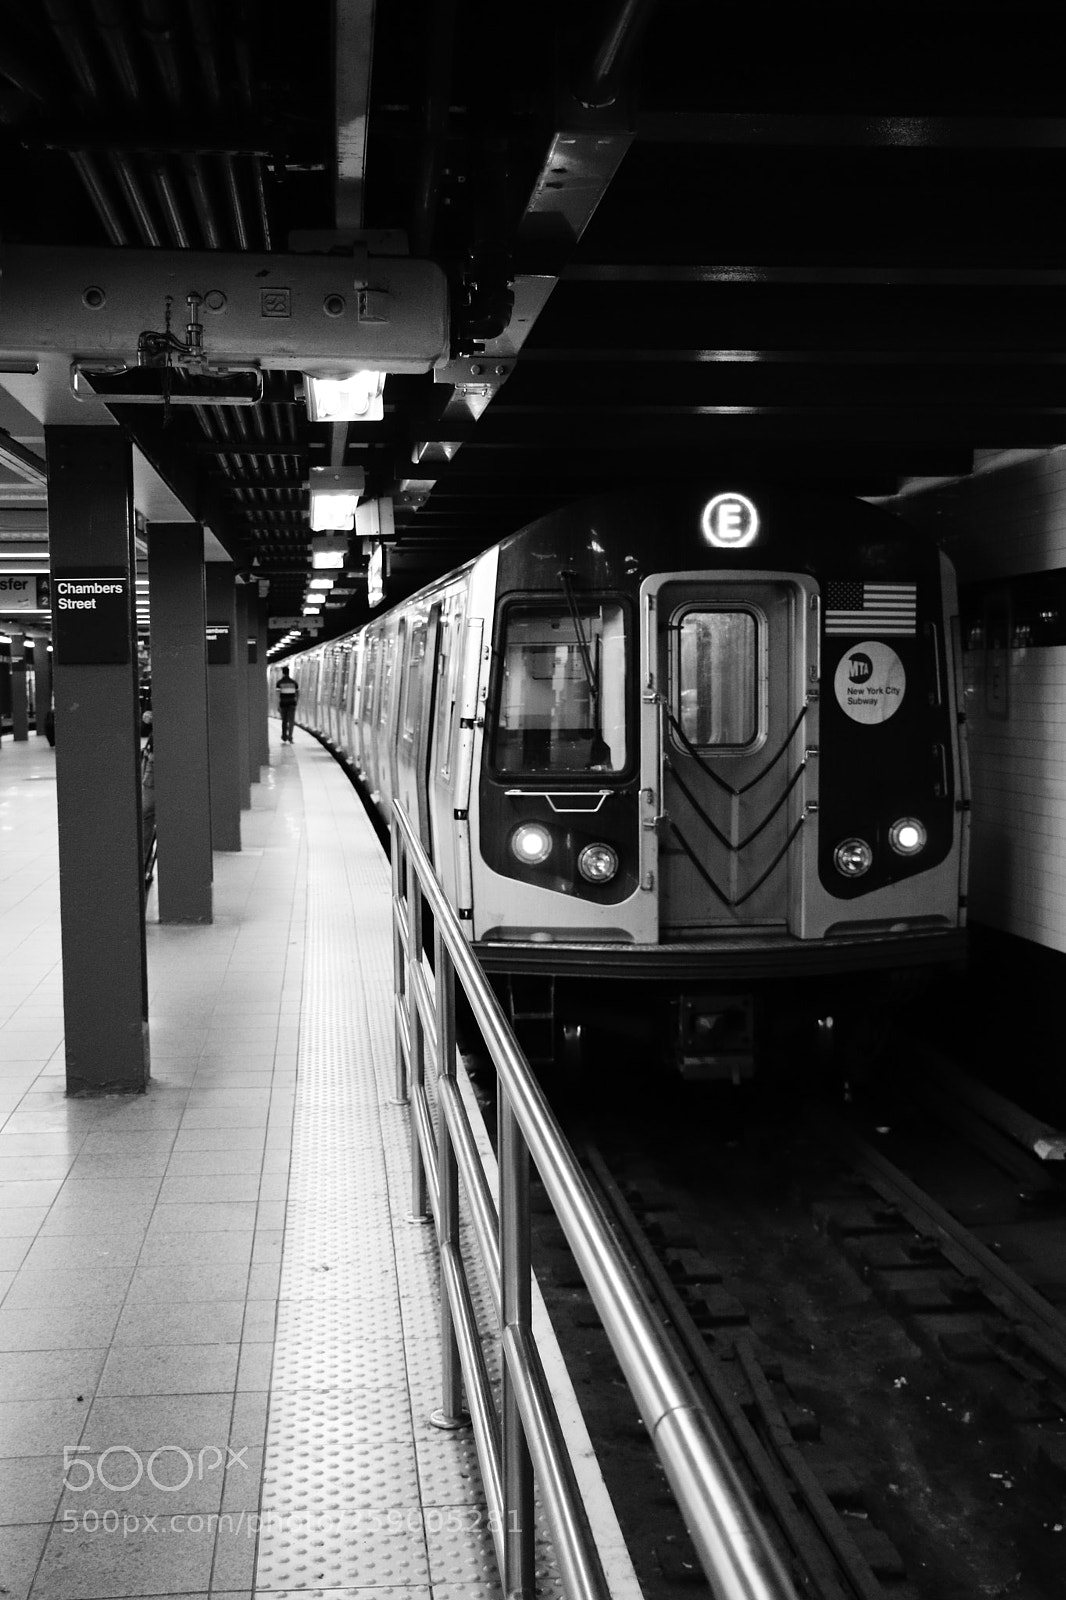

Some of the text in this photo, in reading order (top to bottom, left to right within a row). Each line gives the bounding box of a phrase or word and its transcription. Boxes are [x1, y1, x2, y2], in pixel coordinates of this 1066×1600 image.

[719, 504, 741, 538] E
[57, 582, 123, 594] Chambers
[41, 596, 49, 606] 2
[58, 598, 97, 610] Street
[848, 659, 870, 678] MTA
[847, 686, 900, 696] New York City
[847, 697, 878, 706] Subway
